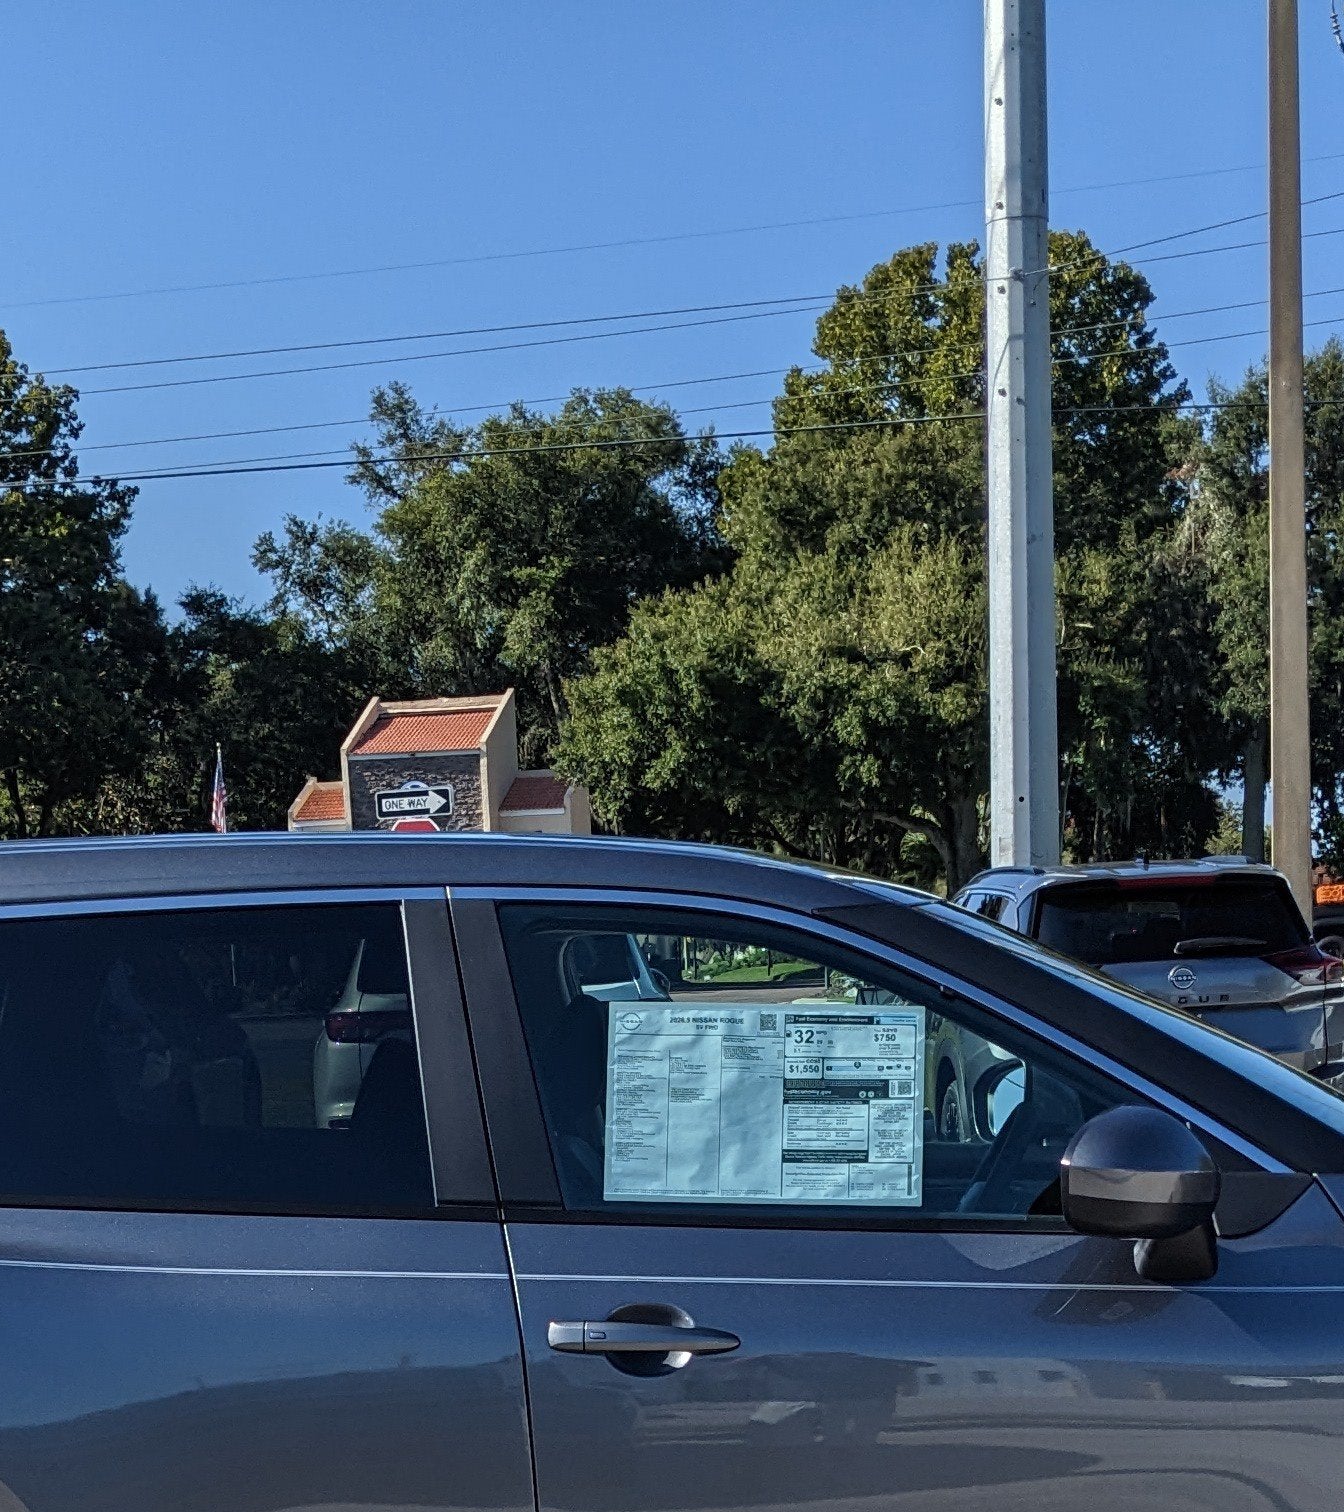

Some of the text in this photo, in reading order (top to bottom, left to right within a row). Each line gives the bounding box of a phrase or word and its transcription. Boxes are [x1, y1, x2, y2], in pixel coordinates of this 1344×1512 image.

[385, 798, 428, 810] ONE WAY
[719, 1017, 745, 1025] ROGUE
[794, 1029, 814, 1044] 32
[873, 1033, 896, 1042] $750
[788, 1064, 820, 1074] $1,550
